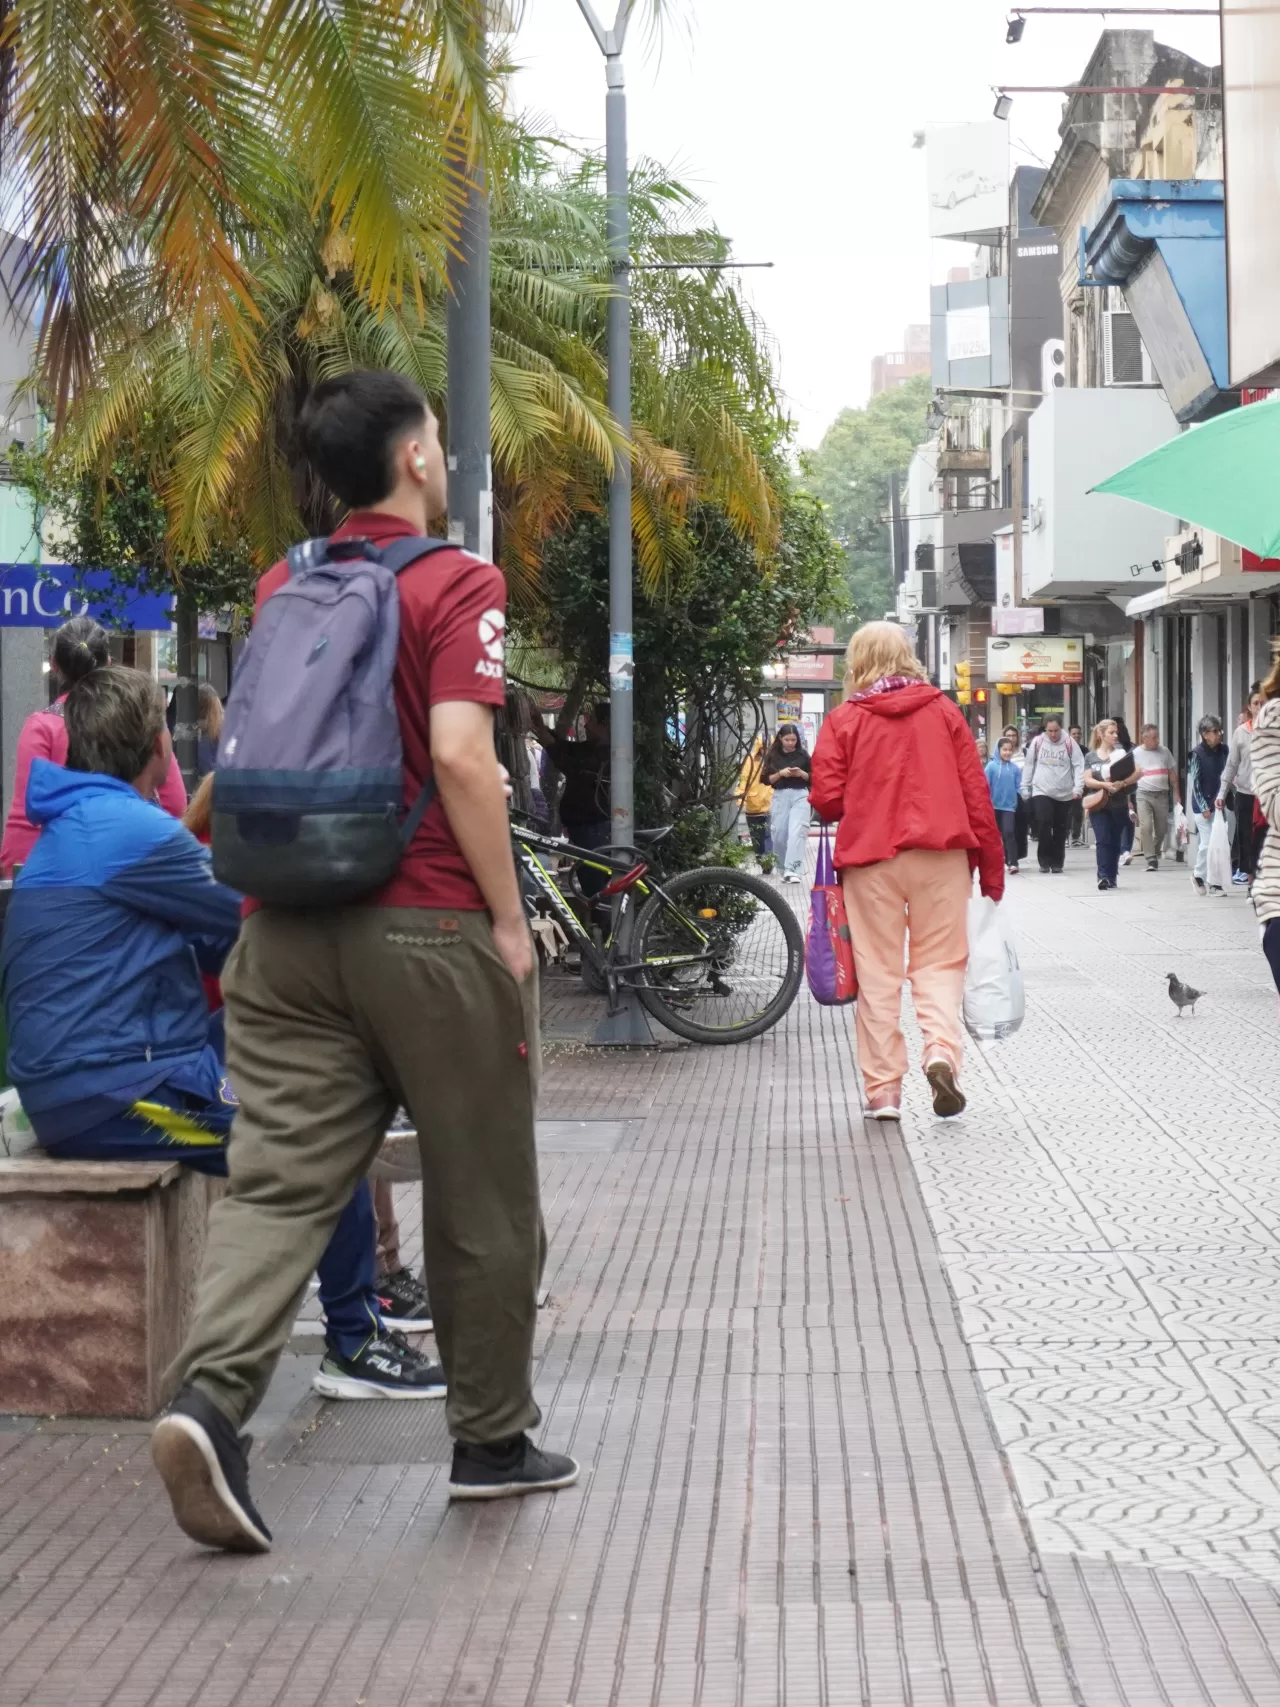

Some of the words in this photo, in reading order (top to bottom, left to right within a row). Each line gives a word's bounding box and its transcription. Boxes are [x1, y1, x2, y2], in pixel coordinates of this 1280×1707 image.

[1017, 245, 1059, 257] SAMSUNG
[513, 829, 541, 841] NORDIC
[366, 1354, 403, 1377] FILA
